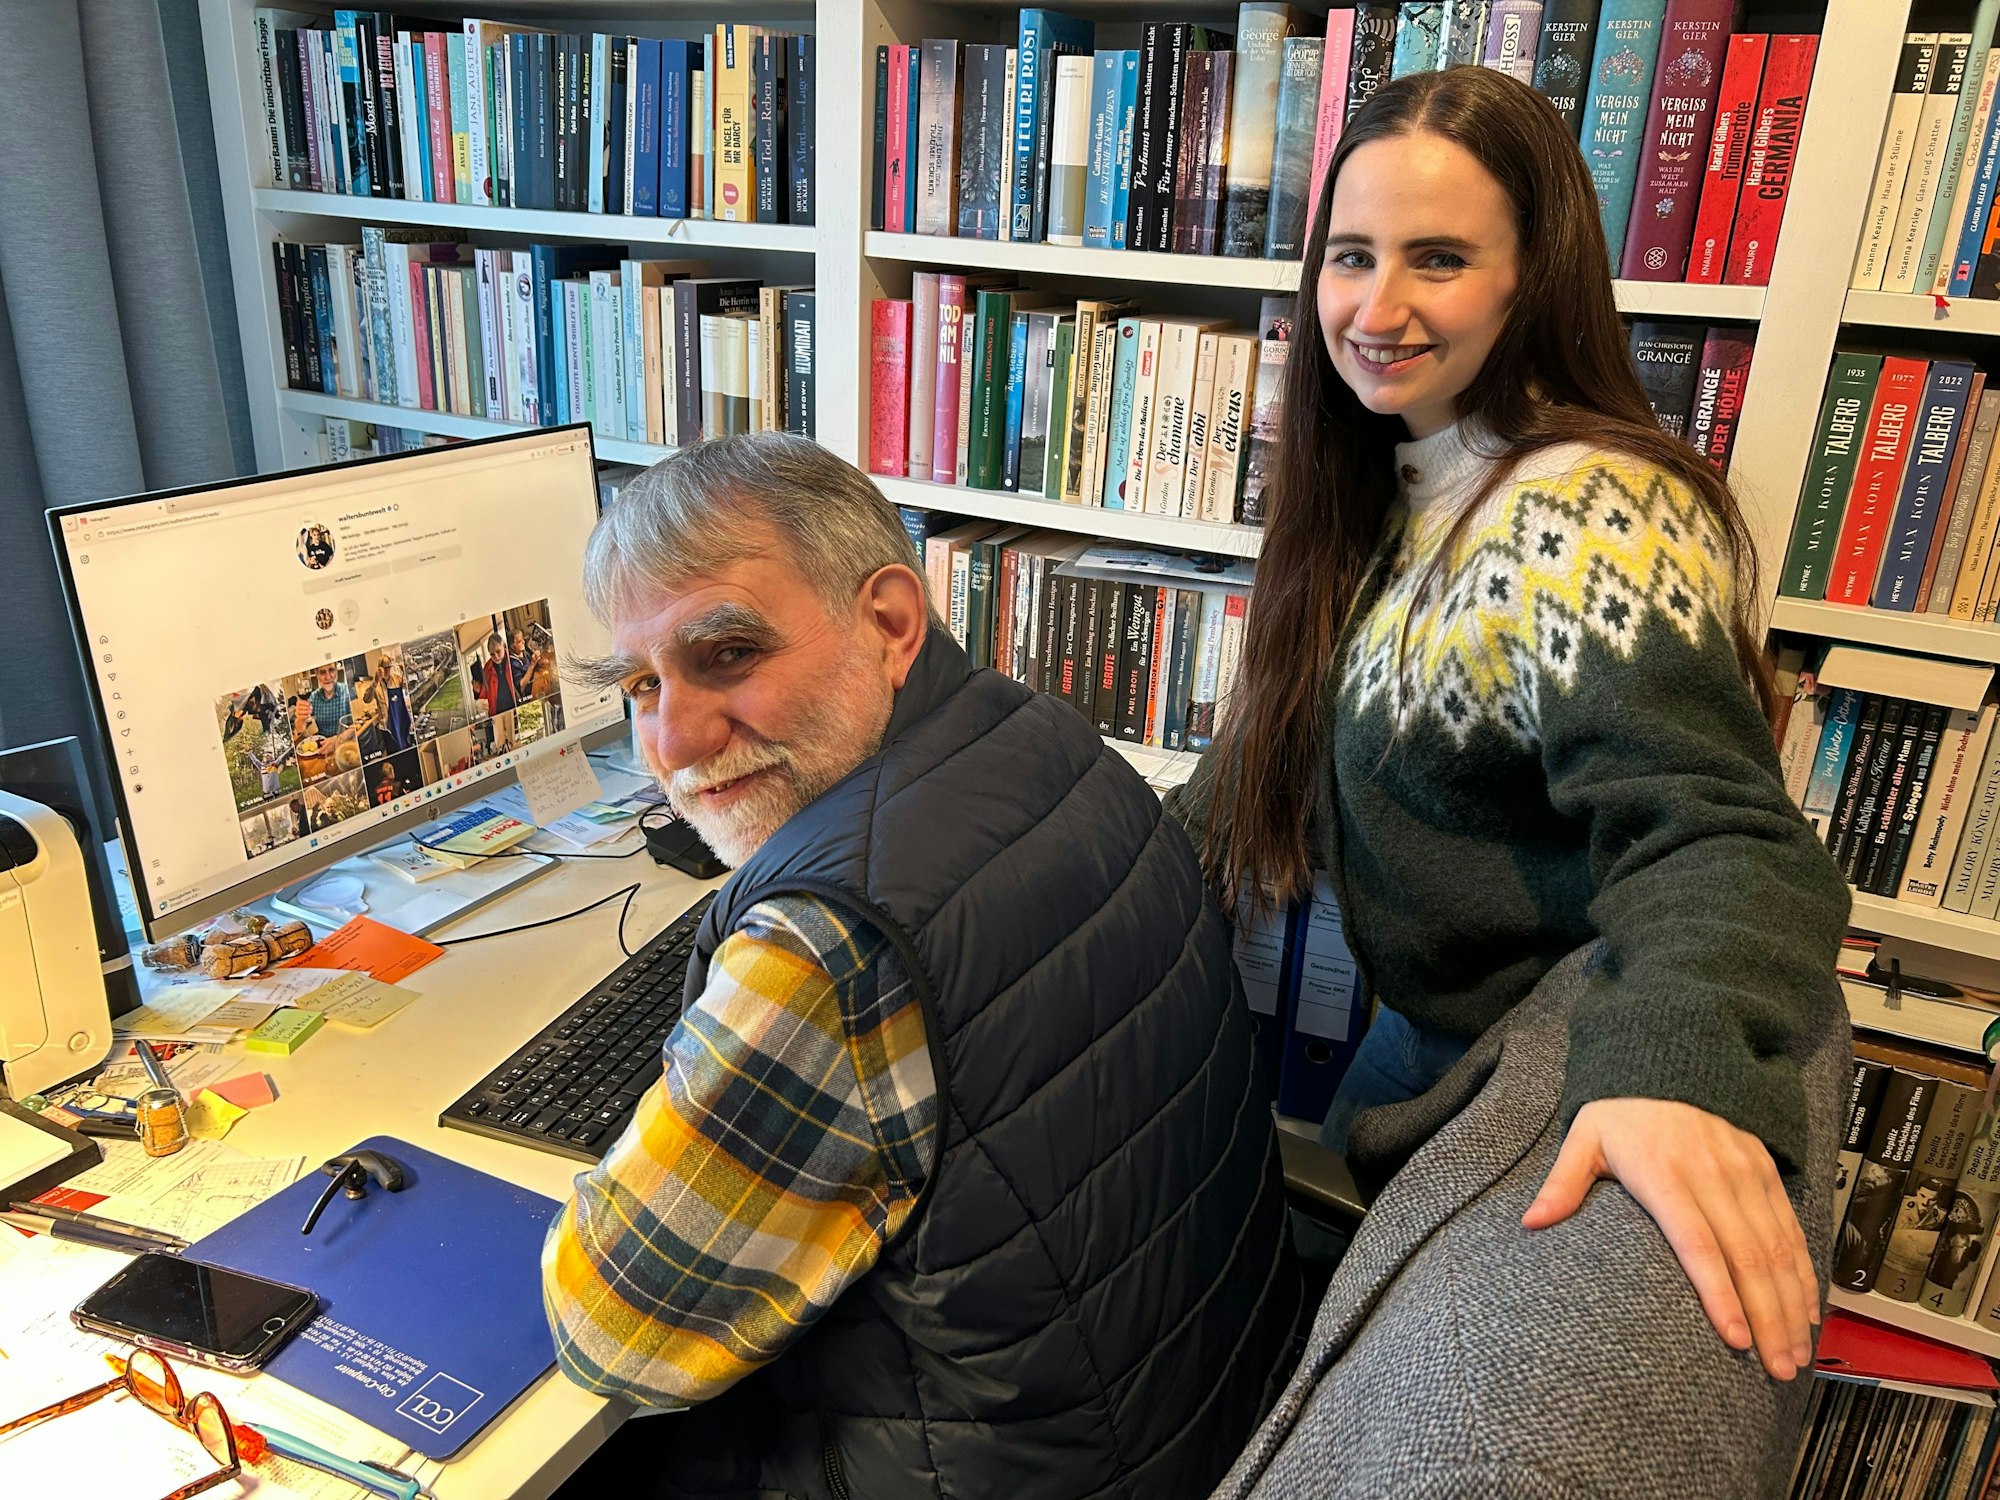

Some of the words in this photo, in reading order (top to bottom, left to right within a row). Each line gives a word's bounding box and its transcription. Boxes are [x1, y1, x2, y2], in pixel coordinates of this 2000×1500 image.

[259, 17, 270, 52] Flagge
[1148, 26, 1156, 46] Licht
[1240, 30, 1278, 44] George
[1544, 23, 1588, 32] KERSTIN
[1552, 32, 1576, 42] GIER
[1607, 20, 1652, 30] KERSTIN
[1616, 30, 1640, 39] GIER
[1674, 21, 1721, 32] KERSTIN
[1682, 32, 1708, 41] GIER
[297, 36, 306, 58] Erbe
[726, 34, 734, 49] Böhm
[1288, 44, 1319, 60] George
[726, 50, 734, 66] Ulrike
[1912, 48, 1932, 92] PIPER
[1946, 48, 1968, 92] PIPER
[262, 51, 276, 108] unsichtbare
[300, 60, 310, 92] Emilys
[1018, 28, 1037, 152] FEUERFROST
[1144, 63, 1154, 96] Schatten
[1170, 64, 1178, 97] Schatten
[722, 108, 732, 124] FÜR
[1144, 96, 1152, 130] zwischen
[1168, 97, 1176, 130] zwischen
[1594, 94, 1639, 109] VERGISS
[1660, 96, 1707, 112] VERGISS
[304, 104, 315, 144] Barnard
[364, 100, 377, 137] Mord
[1600, 110, 1628, 127] MEIN
[1666, 114, 1696, 130] MEIN
[1754, 108, 1774, 146] Gilbers
[272, 127, 280, 160] Bamm
[724, 126, 732, 148] NGEL
[733, 121, 741, 148] DARCY
[1166, 131, 1174, 168] immer
[1594, 130, 1628, 144] NICHT
[1660, 132, 1694, 148] NICHT
[1720, 102, 1752, 181] Trümmertote
[1758, 96, 1803, 200] GERMANIA
[307, 144, 318, 174] Robert
[724, 150, 732, 164] EIN
[734, 150, 741, 164] MR
[1134, 130, 1150, 188] Verbannt
[1746, 148, 1763, 187] Harald
[1019, 156, 1028, 200] GARNER
[1158, 170, 1170, 194] Für
[1650, 180, 1688, 188] ZUSAMMEN
[1136, 206, 1144, 232] Gembri
[1161, 208, 1169, 234] Gembri
[1270, 243, 1294, 251] BLANVALET
[303, 277, 312, 318] Tropfen
[720, 298, 730, 306] Die
[940, 304, 960, 323] TOD
[794, 320, 812, 376] ILLUMINATI
[940, 324, 956, 344] AM
[939, 346, 957, 364] NIL
[1015, 352, 1024, 384] Wellen
[1636, 350, 1692, 364] GRANGÉ
[1846, 368, 1866, 378] 1935
[1892, 373, 1915, 383] 1977
[1938, 376, 1963, 386] 2022
[1696, 368, 1721, 431] GRANGÉ
[1132, 442, 1144, 468] Erben
[1140, 395, 1150, 429] Medicus
[1154, 396, 1185, 479] Schamane
[1190, 412, 1206, 460] Rabbi
[1210, 389, 1242, 482] Medicus
[1212, 426, 1222, 447] Der
[1824, 396, 1862, 456] TALBERG
[1870, 402, 1908, 462] TALBERG
[1917, 406, 1956, 466] TALBERG
[1156, 444, 1166, 462] Der
[1190, 457, 1199, 478] Der
[1160, 482, 1170, 511] Gordon
[1190, 479, 1198, 511] Gordon
[1208, 470, 1218, 498] Gordon
[1818, 465, 1838, 511] KORN
[1863, 470, 1885, 516] KORN
[1910, 474, 1932, 520] KORN
[338, 506, 387, 522] waltersbuntewelt
[1206, 498, 1215, 516] Noah
[1808, 518, 1825, 551] MAX
[1852, 524, 1870, 557] MAX
[1900, 528, 1918, 562] MAX
[952, 568, 960, 600] GREENE
[1066, 582, 1078, 642] Champagner-Fonds
[1110, 590, 1120, 620] Steilhang
[1128, 594, 1145, 641] Weingut
[1108, 620, 1116, 650] Tödlicher
[1141, 611, 1151, 643] Schweigen
[1066, 642, 1074, 656] Der
[1062, 659, 1074, 690] GROTE
[1102, 654, 1115, 686] GROTE
[1130, 669, 1138, 695] GROTE
[1128, 696, 1136, 716] PAUL
[1124, 726, 1136, 738] dtv
[1957, 728, 1972, 753] Tochter
[1824, 762, 1833, 778] Das
[1950, 752, 1962, 776] meine
[1946, 774, 1956, 794] ohne
[1940, 794, 1952, 813] Nicht
[480, 818, 522, 843] Post-it
[1928, 814, 1948, 851] Mahmoody
[1956, 846, 1979, 894] MALORY
[1971, 808, 1990, 846] KÖNIG
[1982, 770, 2000, 806] ARTUS
[1923, 849, 1935, 870] Betty
[1980, 855, 2000, 902] MALORY
[1310, 962, 1350, 976] Gesundheit
[1848, 1106, 1866, 1147] 1895-1928
[1892, 1120, 1910, 1165] Geschichte
[1904, 1105, 1916, 1121] des
[1912, 1086, 1924, 1106] Films
[1882, 1128, 1899, 1160] Toeplitz
[1902, 1124, 1923, 1164] 1928-1933
[1925, 1135, 1942, 1168] Toeplitz
[1946, 1132, 1966, 1173] 1934-1939
[1967, 1144, 1984, 1178] Toeplitz
[1852, 1270, 1868, 1287] 2
[1930, 1292, 1944, 1308] 4
[334, 1363, 397, 1398] City-Computer
[412, 1394, 454, 1425] CCL
